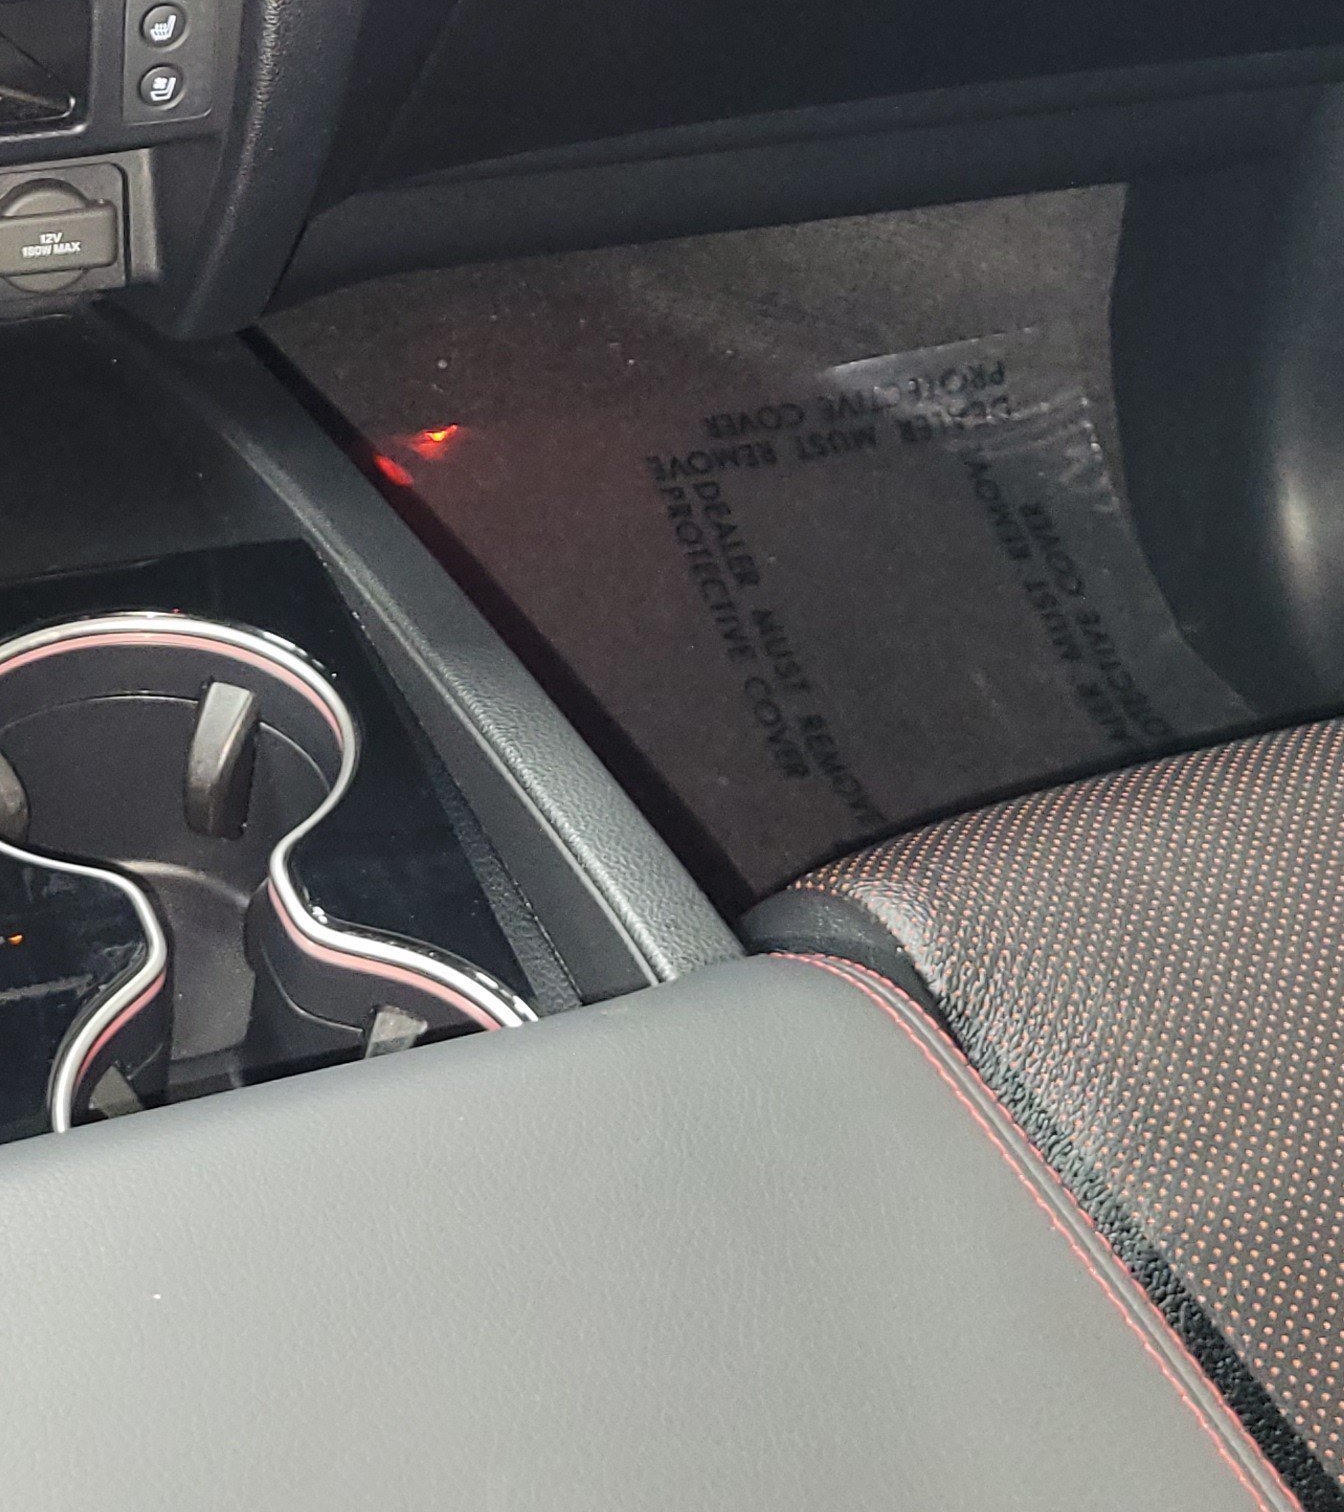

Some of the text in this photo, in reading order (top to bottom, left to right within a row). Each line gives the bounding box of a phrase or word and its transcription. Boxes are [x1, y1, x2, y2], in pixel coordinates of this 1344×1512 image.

[40, 232, 62, 245] 12V
[53, 241, 81, 255] MAX
[645, 444, 777, 481] REMOVE
[660, 484, 811, 780] PROTECTIVE COVER
